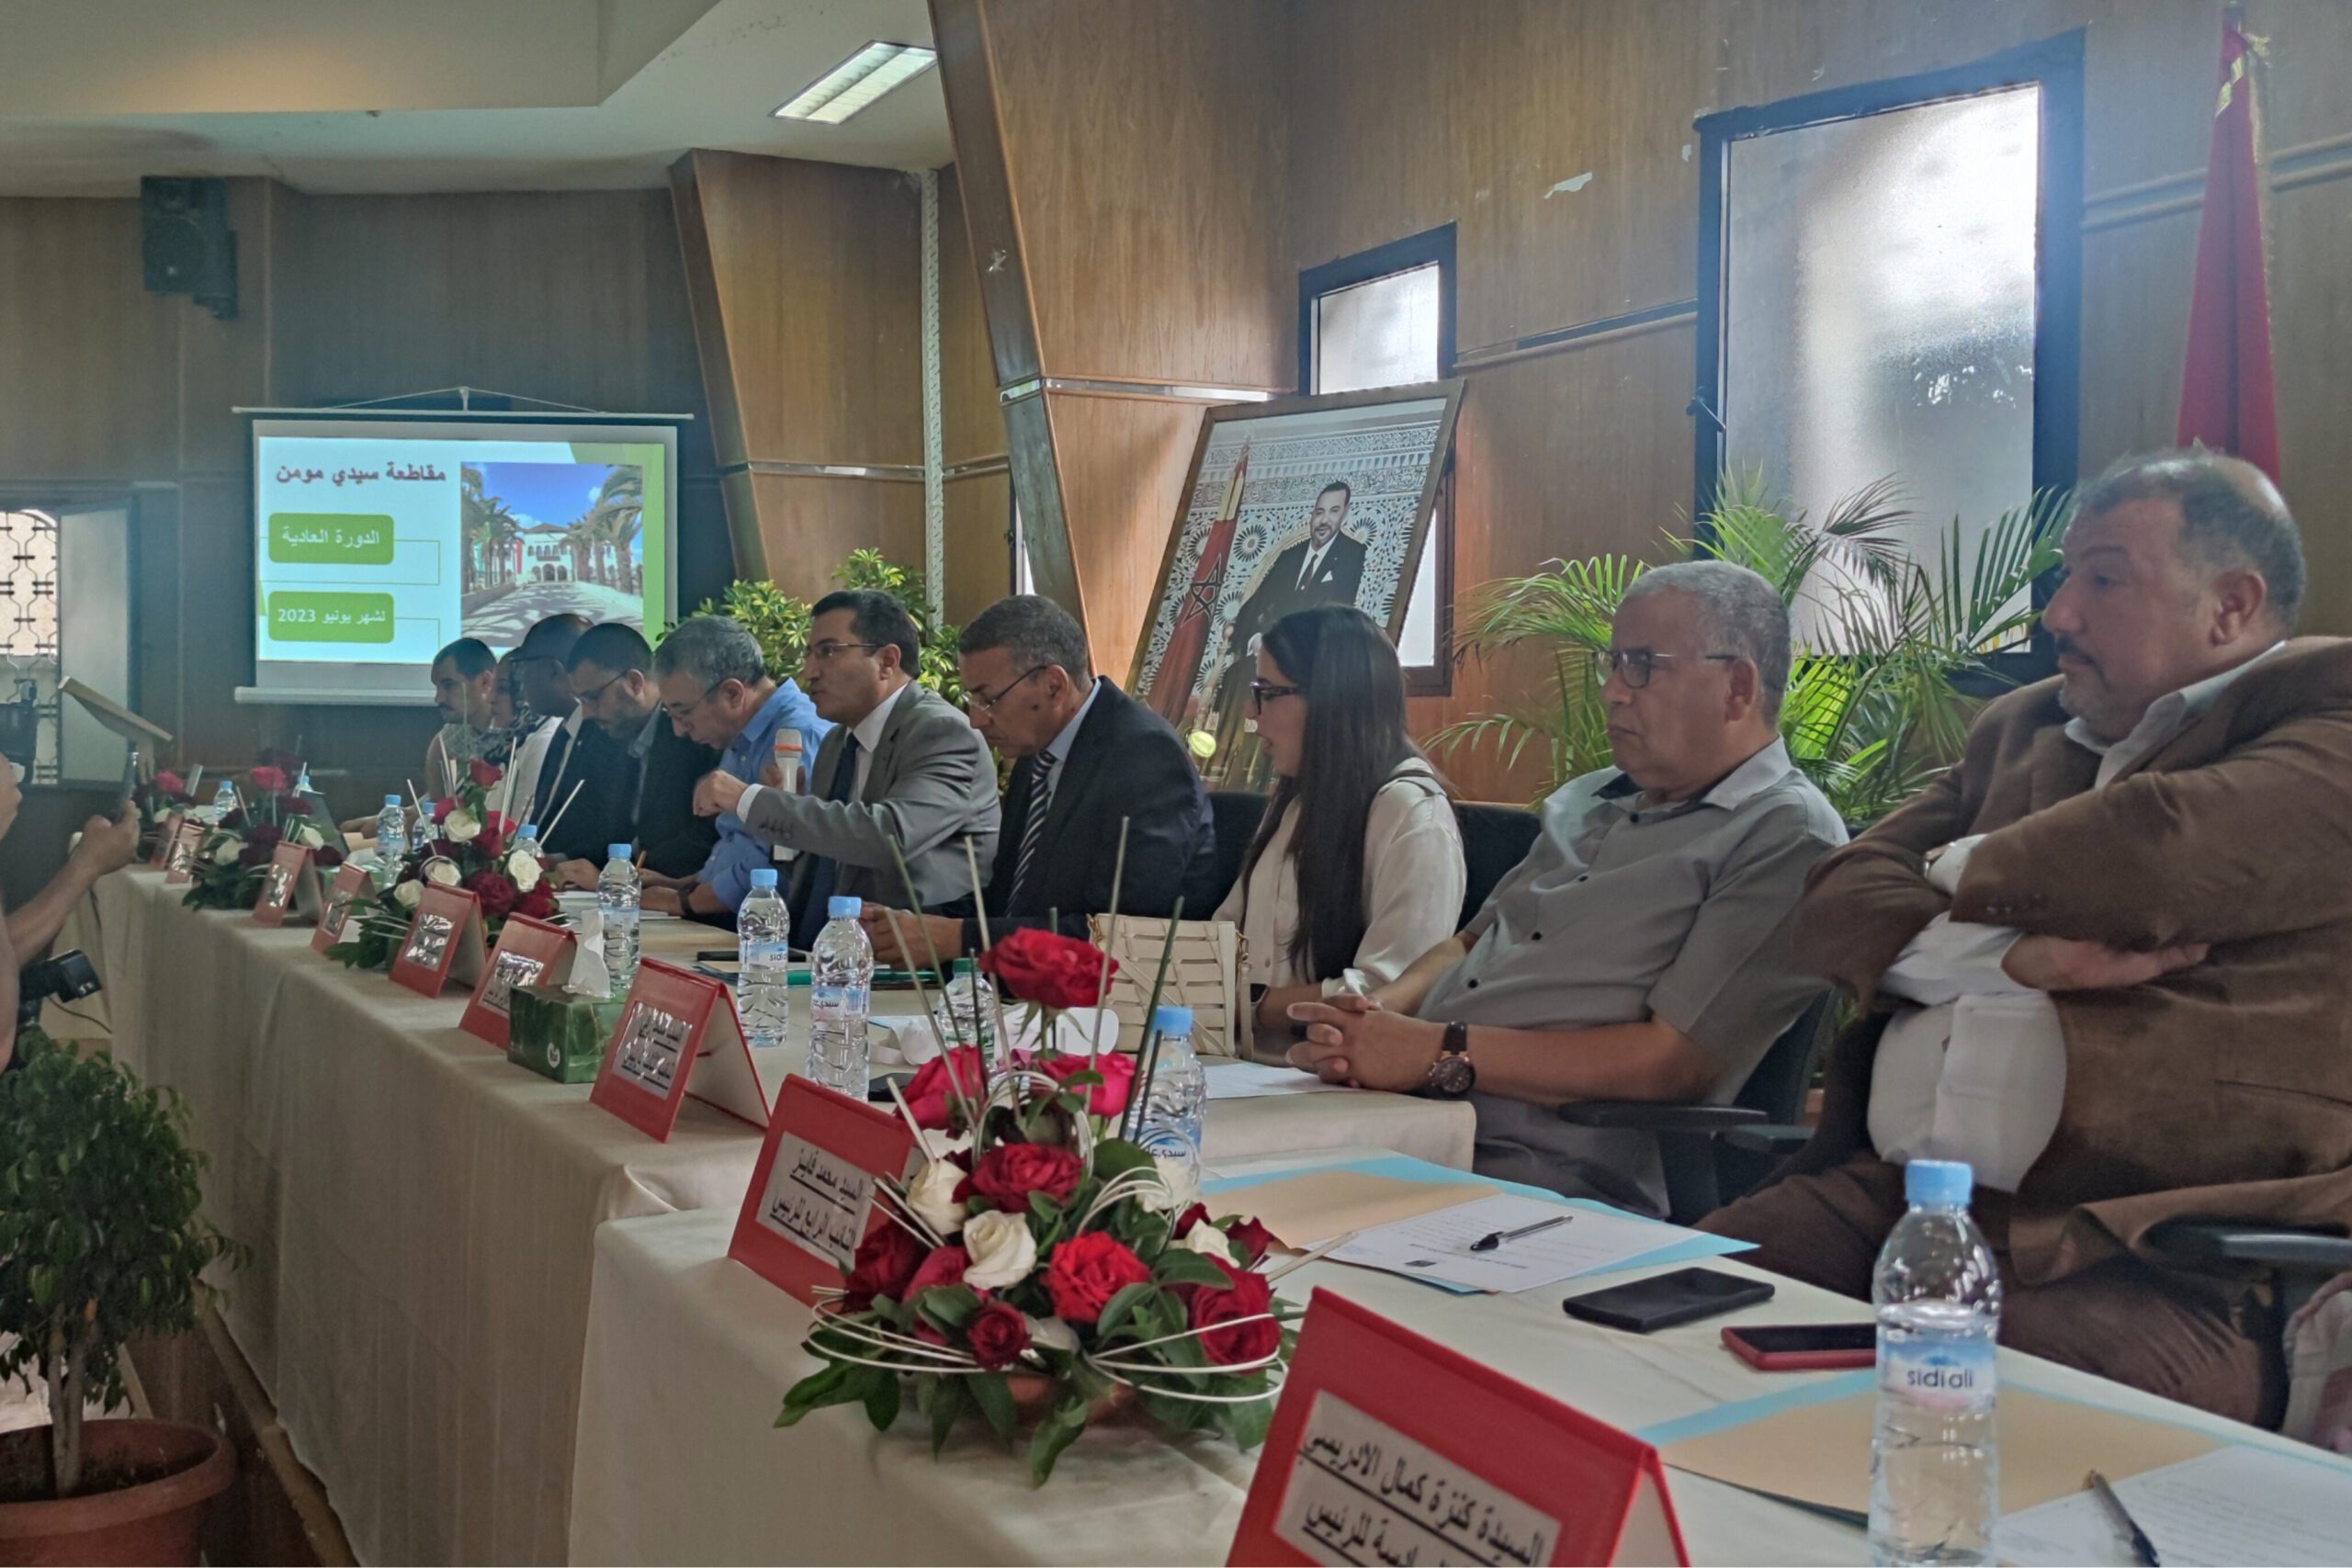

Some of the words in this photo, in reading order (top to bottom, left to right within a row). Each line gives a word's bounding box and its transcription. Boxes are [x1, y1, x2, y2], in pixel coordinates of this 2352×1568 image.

[276, 466, 324, 484] مومن
[332, 467, 379, 487] سيدي
[386, 461, 447, 481] مقاطعة
[282, 526, 329, 547] العادية
[335, 529, 380, 548] الدورة
[277, 609, 316, 623] 2023
[322, 611, 352, 626] يونيو
[357, 610, 386, 626] لشهر
[1907, 1368, 1945, 1388] sidi
[1380, 1457, 1428, 1505] كمال
[1305, 1500, 1372, 1548] للرئيس
[1477, 1506, 1544, 1566] السيدة
